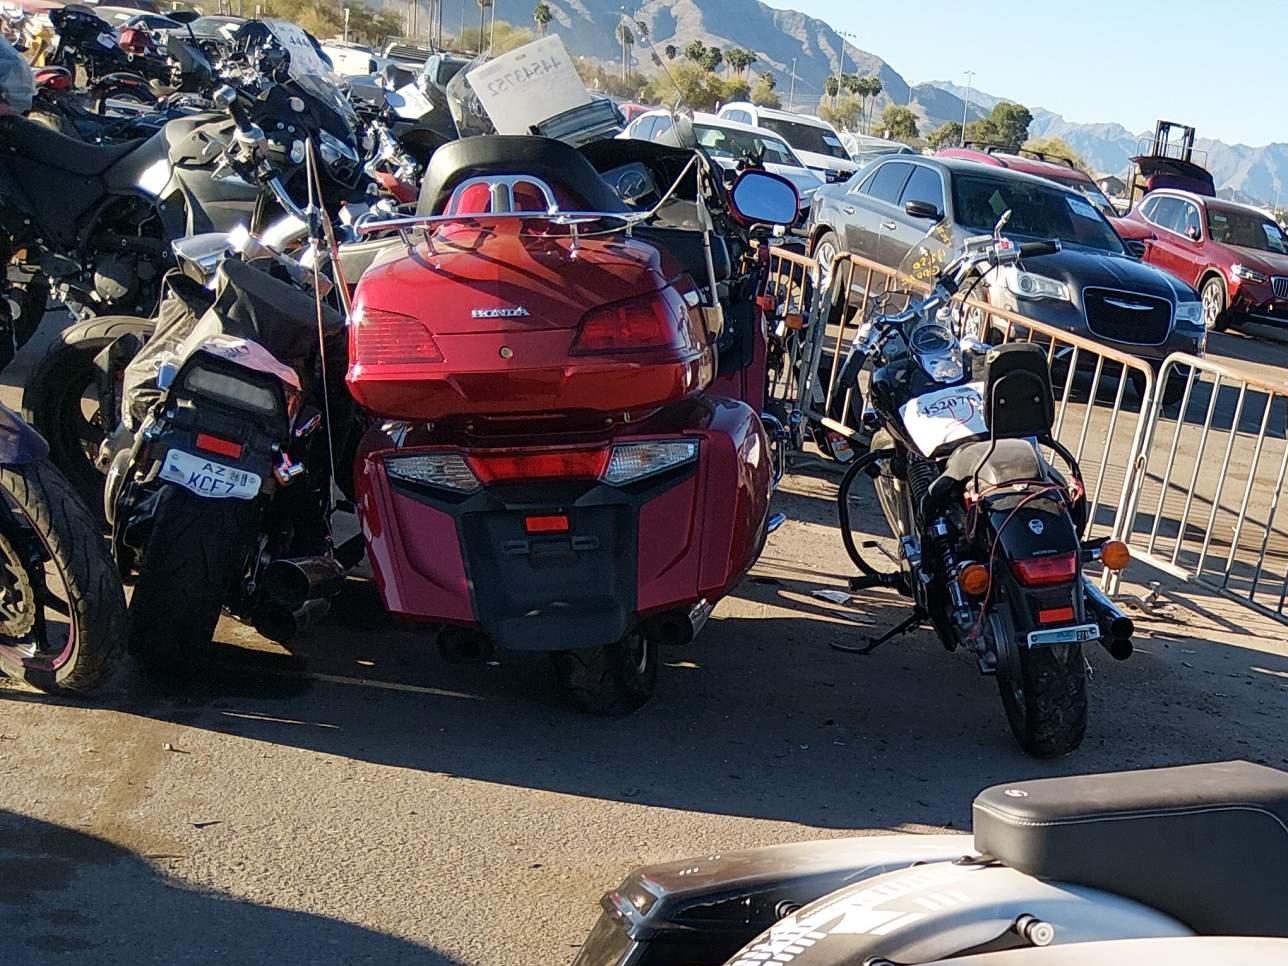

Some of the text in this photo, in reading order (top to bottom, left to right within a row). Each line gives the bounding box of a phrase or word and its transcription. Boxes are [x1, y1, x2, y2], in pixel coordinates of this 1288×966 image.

[471, 306, 530, 319] HONDA
[202, 463, 226, 477] AZ
[188, 471, 236, 494] KCF7
